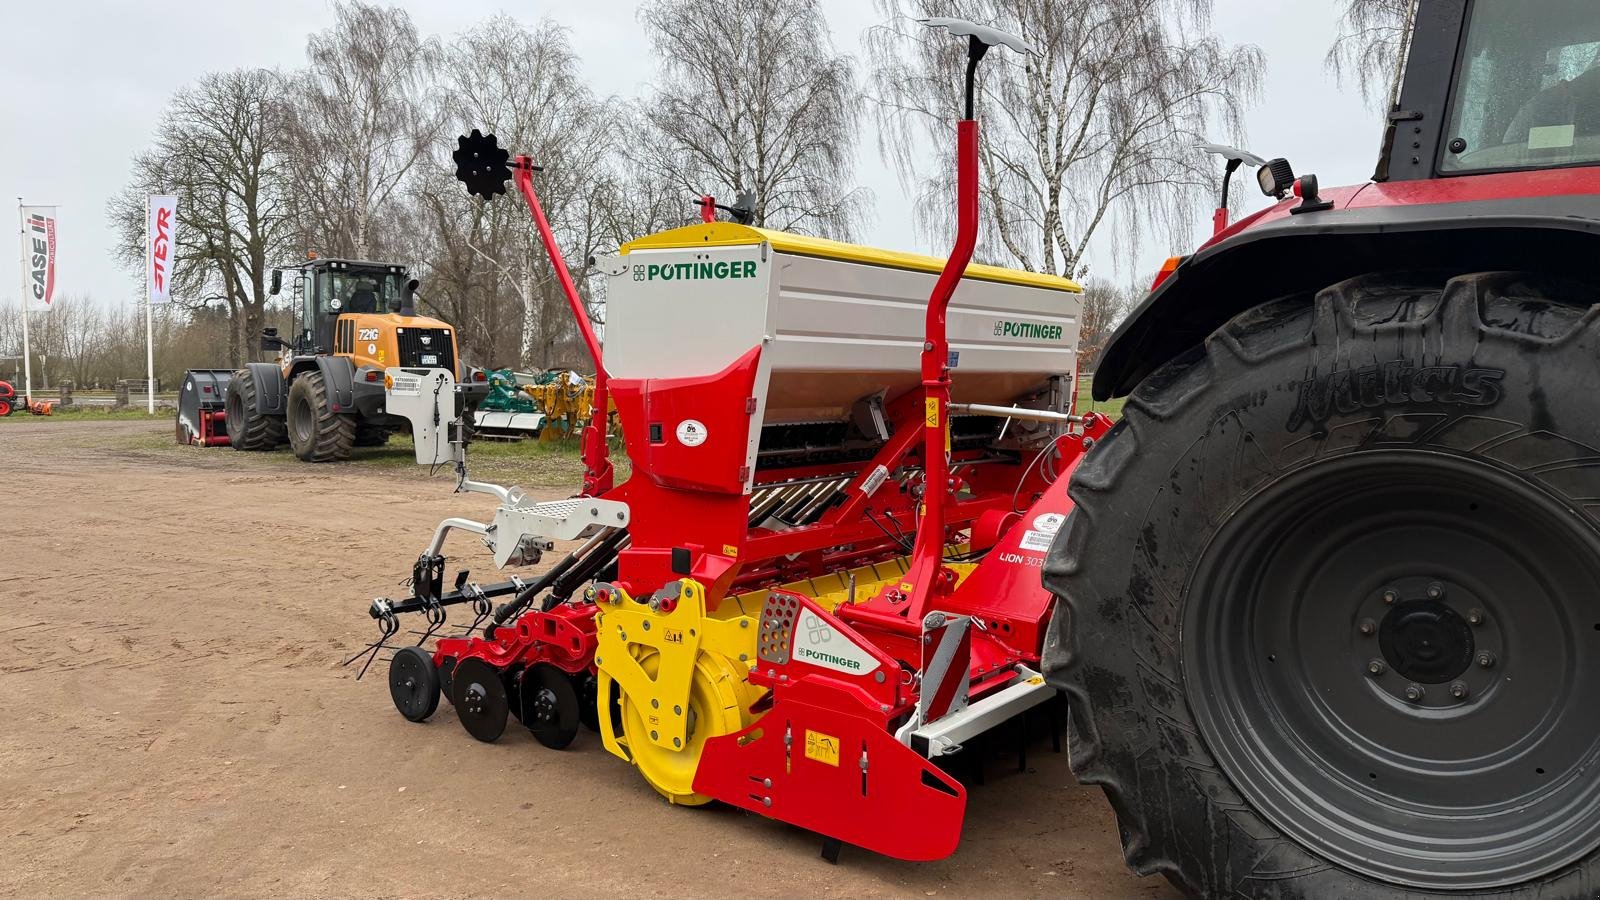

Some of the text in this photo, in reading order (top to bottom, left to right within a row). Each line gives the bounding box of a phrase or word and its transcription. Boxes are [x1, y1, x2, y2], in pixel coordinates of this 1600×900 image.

[47, 218, 56, 265] AGRICULTURE
[154, 207, 171, 294] STEYR
[32, 237, 47, 299] CASE
[648, 261, 757, 281] PÖTTINGER
[358, 328, 379, 341] 721G
[1003, 321, 1063, 340] PÖTTINGER
[1000, 552, 1043, 567] LION 303
[806, 649, 861, 670] PÖTTINGER
